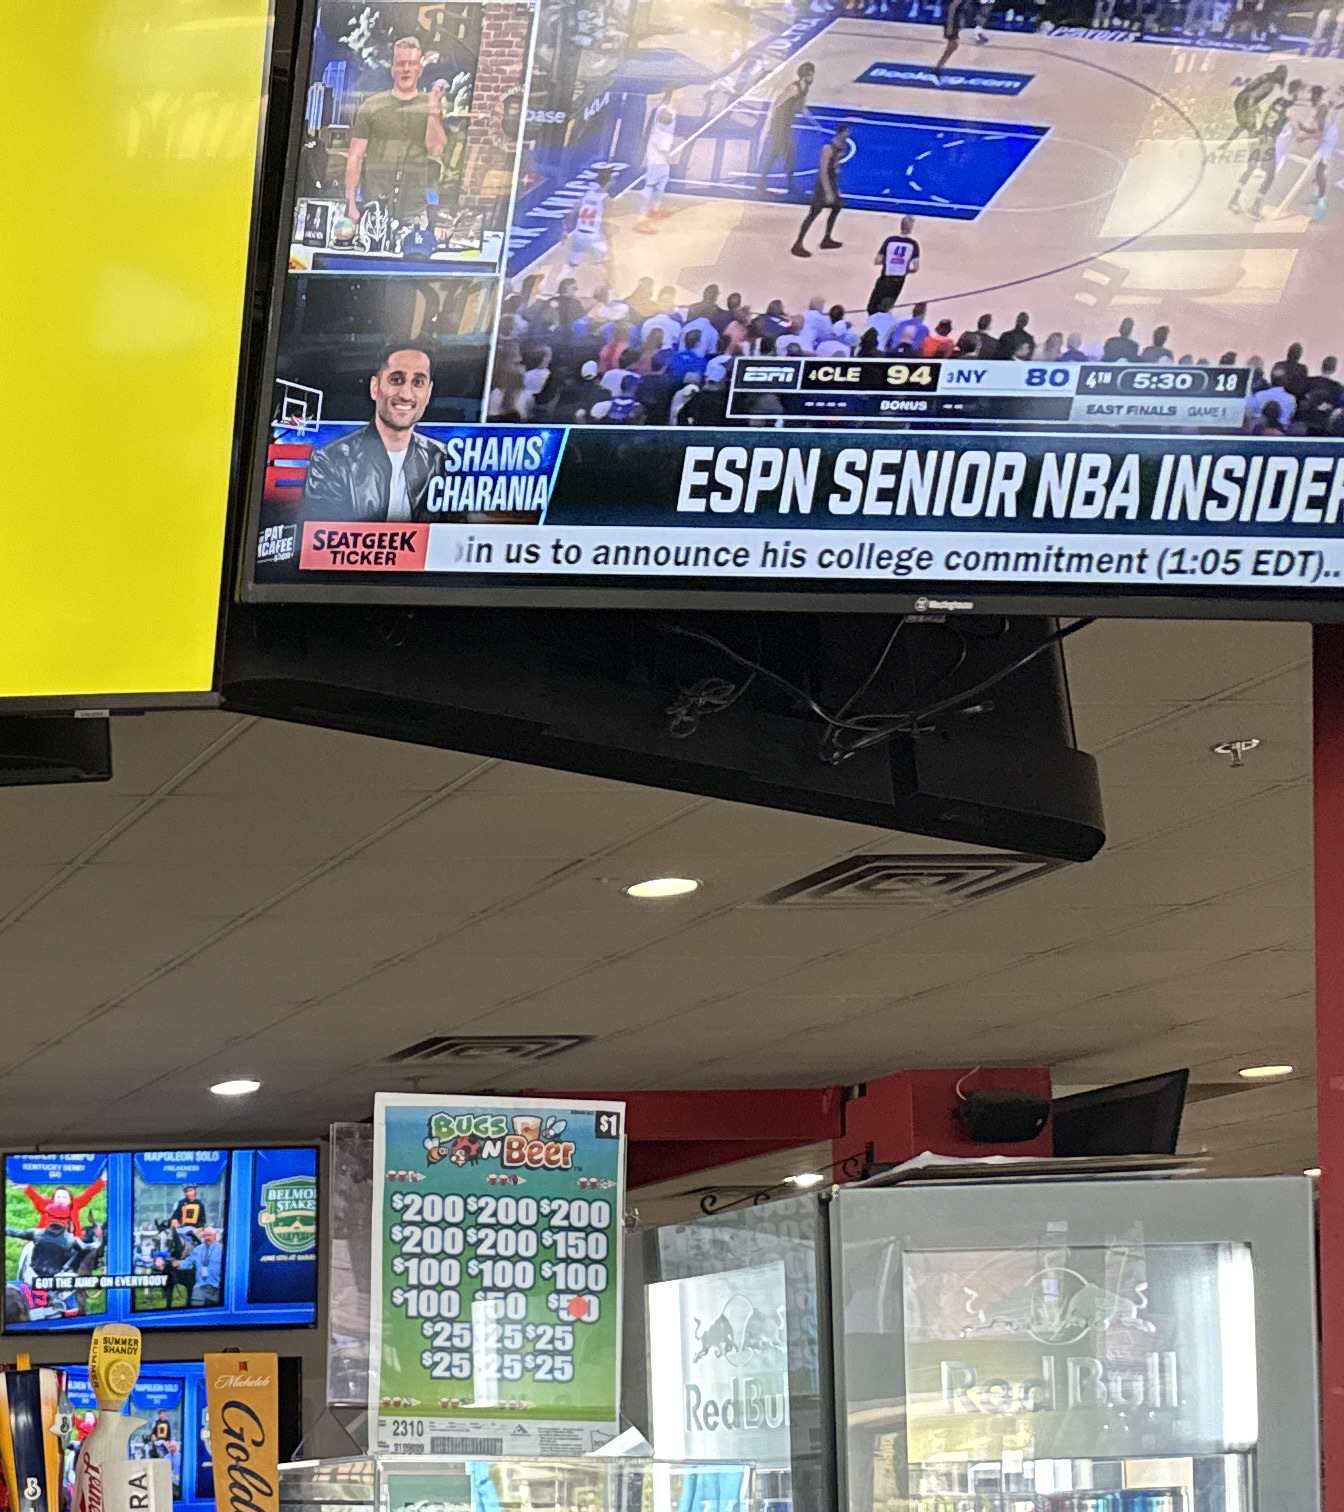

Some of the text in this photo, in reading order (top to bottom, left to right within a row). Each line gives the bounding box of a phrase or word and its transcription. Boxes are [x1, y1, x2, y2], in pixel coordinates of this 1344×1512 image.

[886, 365, 932, 386] 94
[1025, 368, 1070, 388] 80
[1133, 373, 1193, 390] 5:30
[445, 436, 544, 472] SHAMS
[427, 475, 549, 512] CHARANIA
[677, 446, 821, 514] ESPN
[828, 449, 1026, 518] SENIOR
[1032, 451, 1144, 520] NBA
[312, 529, 418, 553] SEATGEEK
[330, 550, 397, 566] TICKER
[467, 536, 493, 563] in
[506, 541, 541, 565] us
[552, 540, 583, 565] to
[592, 543, 750, 568] announce
[760, 541, 807, 568] his
[817, 544, 933, 577] college
[944, 545, 1149, 575] commitment
[1156, 547, 1241, 581] (1:05
[431, 1112, 508, 1142] BUGS
[599, 1115, 618, 1136] $1
[482, 1136, 576, 1169] N Beer
[392, 1193, 611, 1229] $200 $200 $200
[392, 1225, 608, 1260] $200 $200 $150
[36, 1274, 168, 1289] GOT THE JUMP ON EVERYBODY
[393, 1257, 608, 1292] $100 $100 $100
[392, 1288, 461, 1319] $100
[103, 1336, 140, 1347] SUMMER
[104, 1345, 140, 1356] SHANDY
[423, 1321, 574, 1352] $25 $25
[214, 1374, 271, 1391] Michelob
[422, 1351, 574, 1383] $25 $25
[941, 1351, 1179, 1413] Red Bull
[684, 1377, 737, 1432] Red
[392, 1420, 424, 1437] 2310
